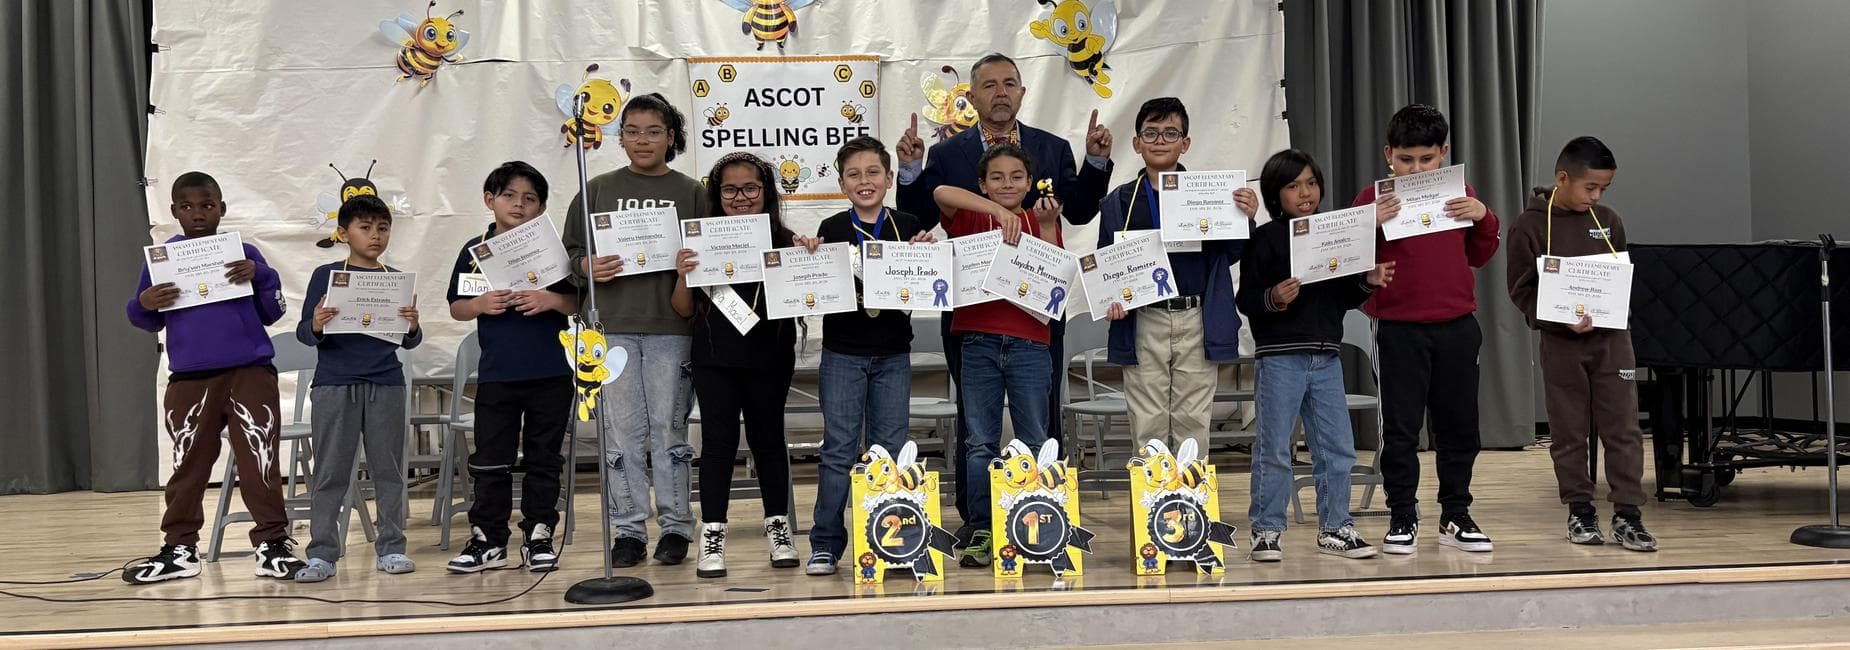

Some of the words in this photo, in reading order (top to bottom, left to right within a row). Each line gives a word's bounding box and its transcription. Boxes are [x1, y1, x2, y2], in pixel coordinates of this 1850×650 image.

[723, 68, 732, 80] B
[838, 68, 848, 80] C
[696, 82, 705, 93] A
[864, 84, 873, 95] D
[744, 87, 825, 108] ASCOT
[702, 127, 818, 148] SPELLING
[1402, 175, 1442, 188] CERTIFICATE
[618, 216, 657, 225] CERTIFICATE
[1317, 217, 1356, 230] CERTIFICATE
[709, 224, 750, 234] CERTIFICATE
[499, 231, 535, 250] CERTIFICATE
[176, 244, 219, 257] CERTIFICATE
[1026, 246, 1061, 264] CERTIFICATE
[1103, 245, 1143, 263] CERTIFICATE
[789, 253, 830, 263] CERTIFICATE
[1011, 255, 1034, 273] Jayden
[793, 273, 811, 281] Joseph
[885, 265, 913, 277] Joseph
[917, 265, 937, 276] Prado
[1102, 271, 1124, 282] Diego
[1127, 260, 1156, 274] Ramirez
[1568, 267, 1609, 277] CERTIFICATE
[463, 280, 489, 293] Dilan
[881, 515, 916, 547] 2nd
[1022, 511, 1053, 545] 1ST
[1162, 510, 1195, 544] 3rd
